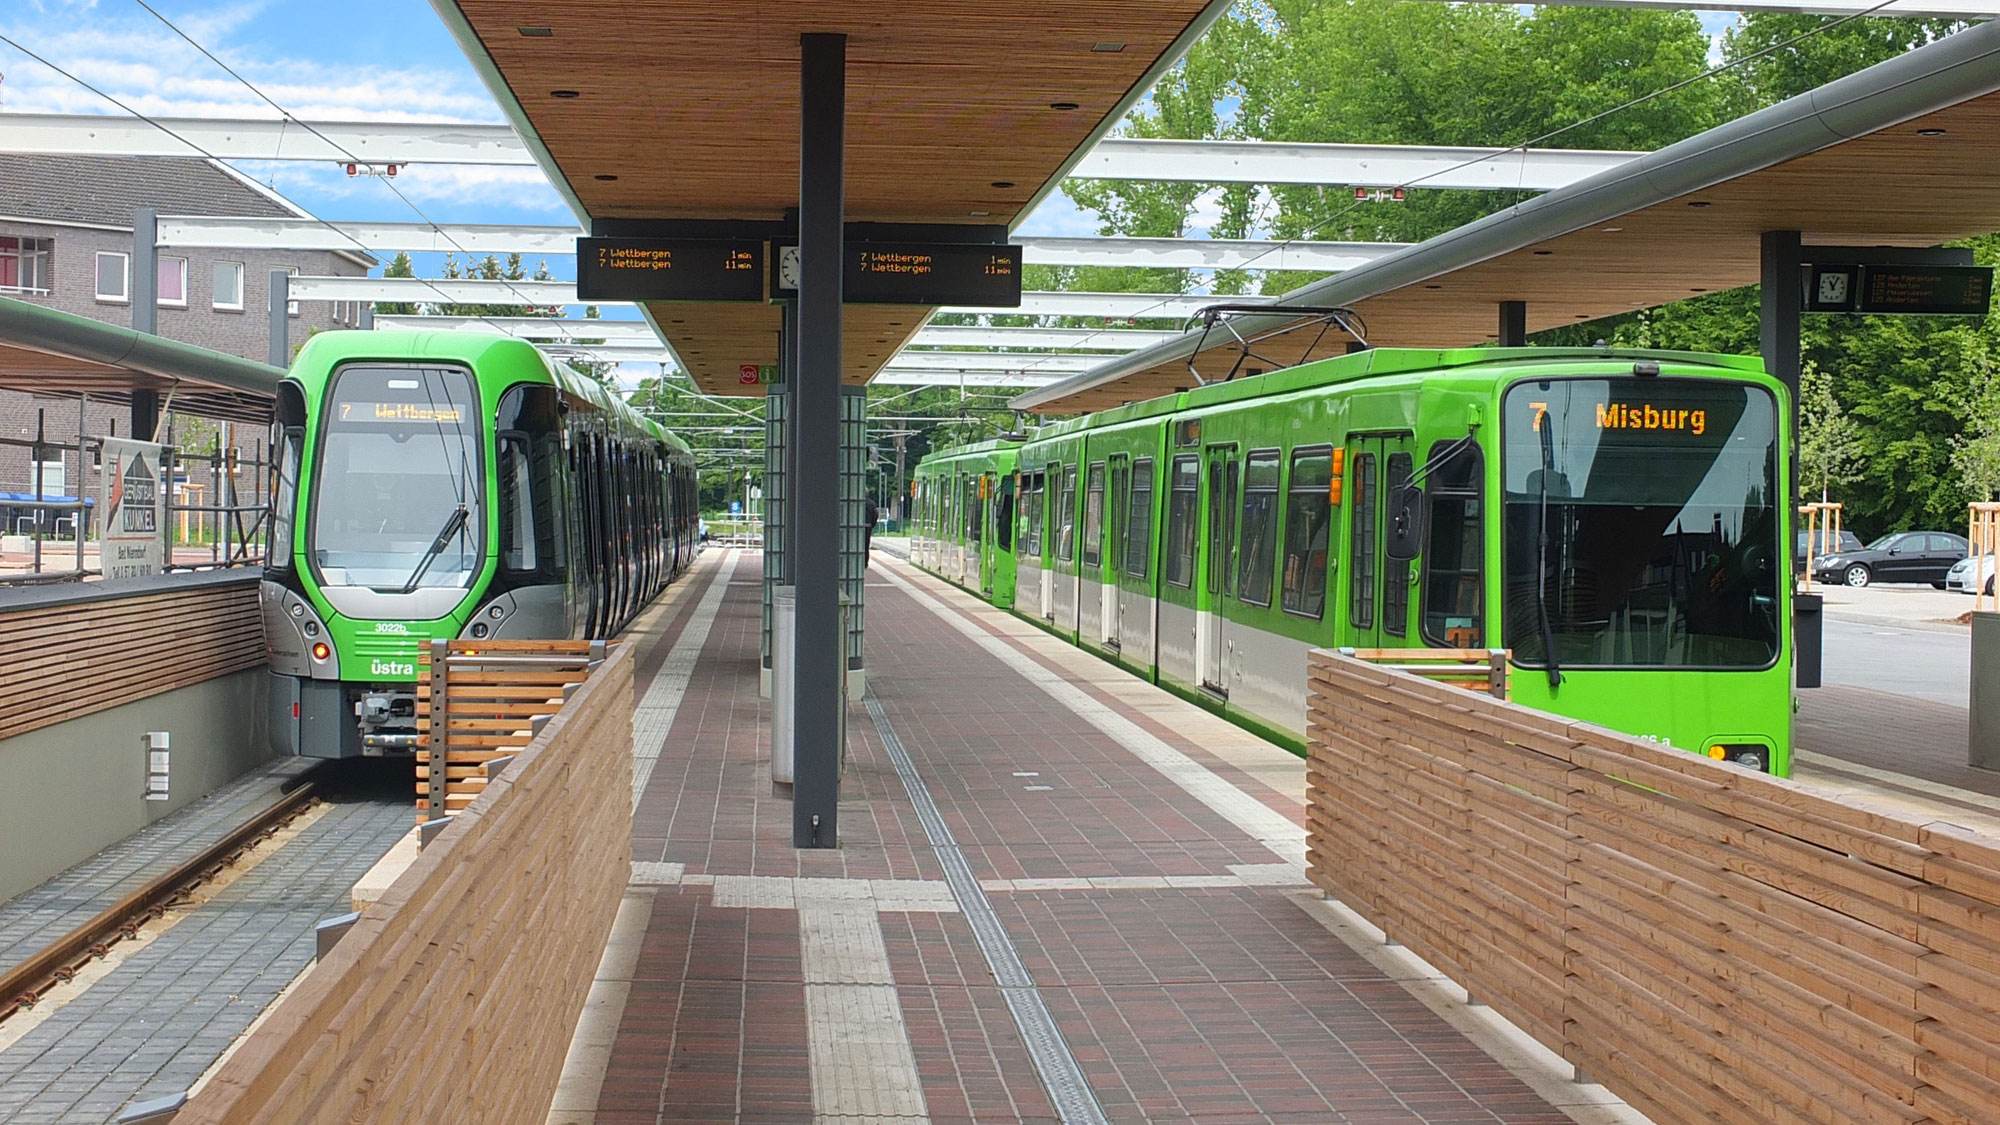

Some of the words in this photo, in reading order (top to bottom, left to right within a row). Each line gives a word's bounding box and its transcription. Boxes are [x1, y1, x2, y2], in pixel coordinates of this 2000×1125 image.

[599, 248, 606, 257] 7
[610, 248, 671, 260] Wettbergen
[861, 253, 867, 262] 7
[871, 252, 932, 264] Wettbergen
[599, 259, 606, 268] 7
[610, 259, 671, 270] Wettbergen
[861, 262, 867, 271] 7
[871, 262, 932, 275] Wettbergen
[341, 404, 351, 420] 7
[375, 403, 460, 421] Wettbergen
[1529, 402, 1547, 432] 7
[1596, 403, 1705, 435] Misburg
[124, 509, 154, 530] KUNKEL
[375, 623, 407, 633] 3022b
[371, 659, 414, 675] üstra
